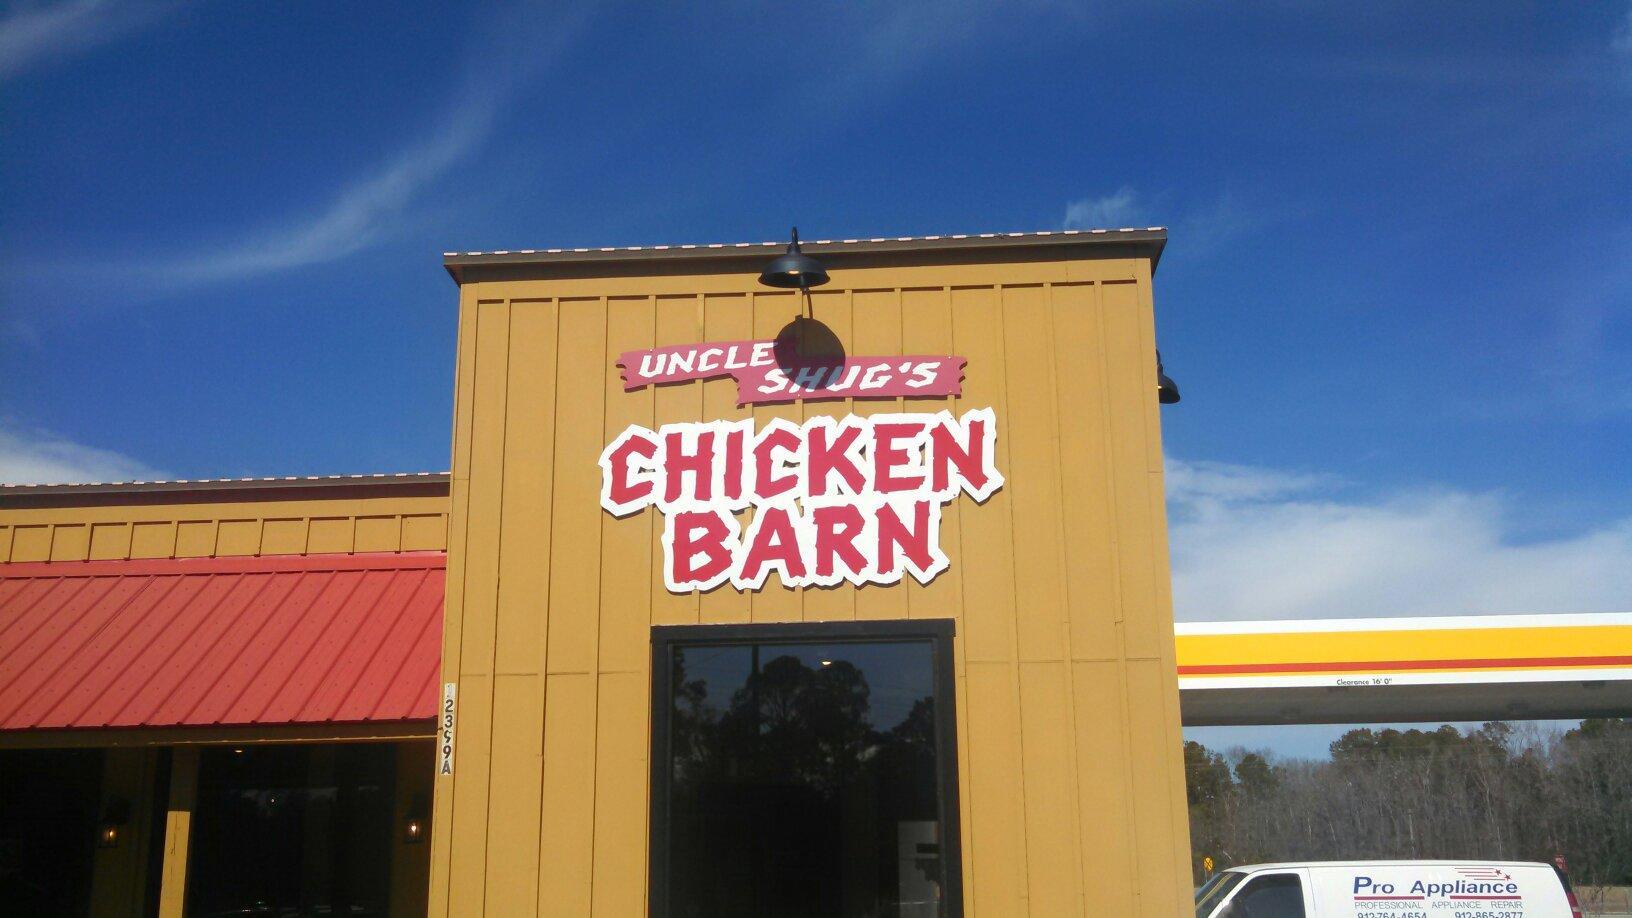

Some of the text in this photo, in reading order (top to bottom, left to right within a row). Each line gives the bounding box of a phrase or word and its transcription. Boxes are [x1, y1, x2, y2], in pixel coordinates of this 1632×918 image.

[638, 342, 778, 378] UNCLE
[757, 361, 941, 394] SHUG'S
[608, 419, 990, 503] CHICKEN
[672, 500, 935, 584] BARN
[1353, 876, 1518, 897] Pro Appliance
[1354, 900, 1524, 909] PROFESSIONAL APPLIANCE REPAIR
